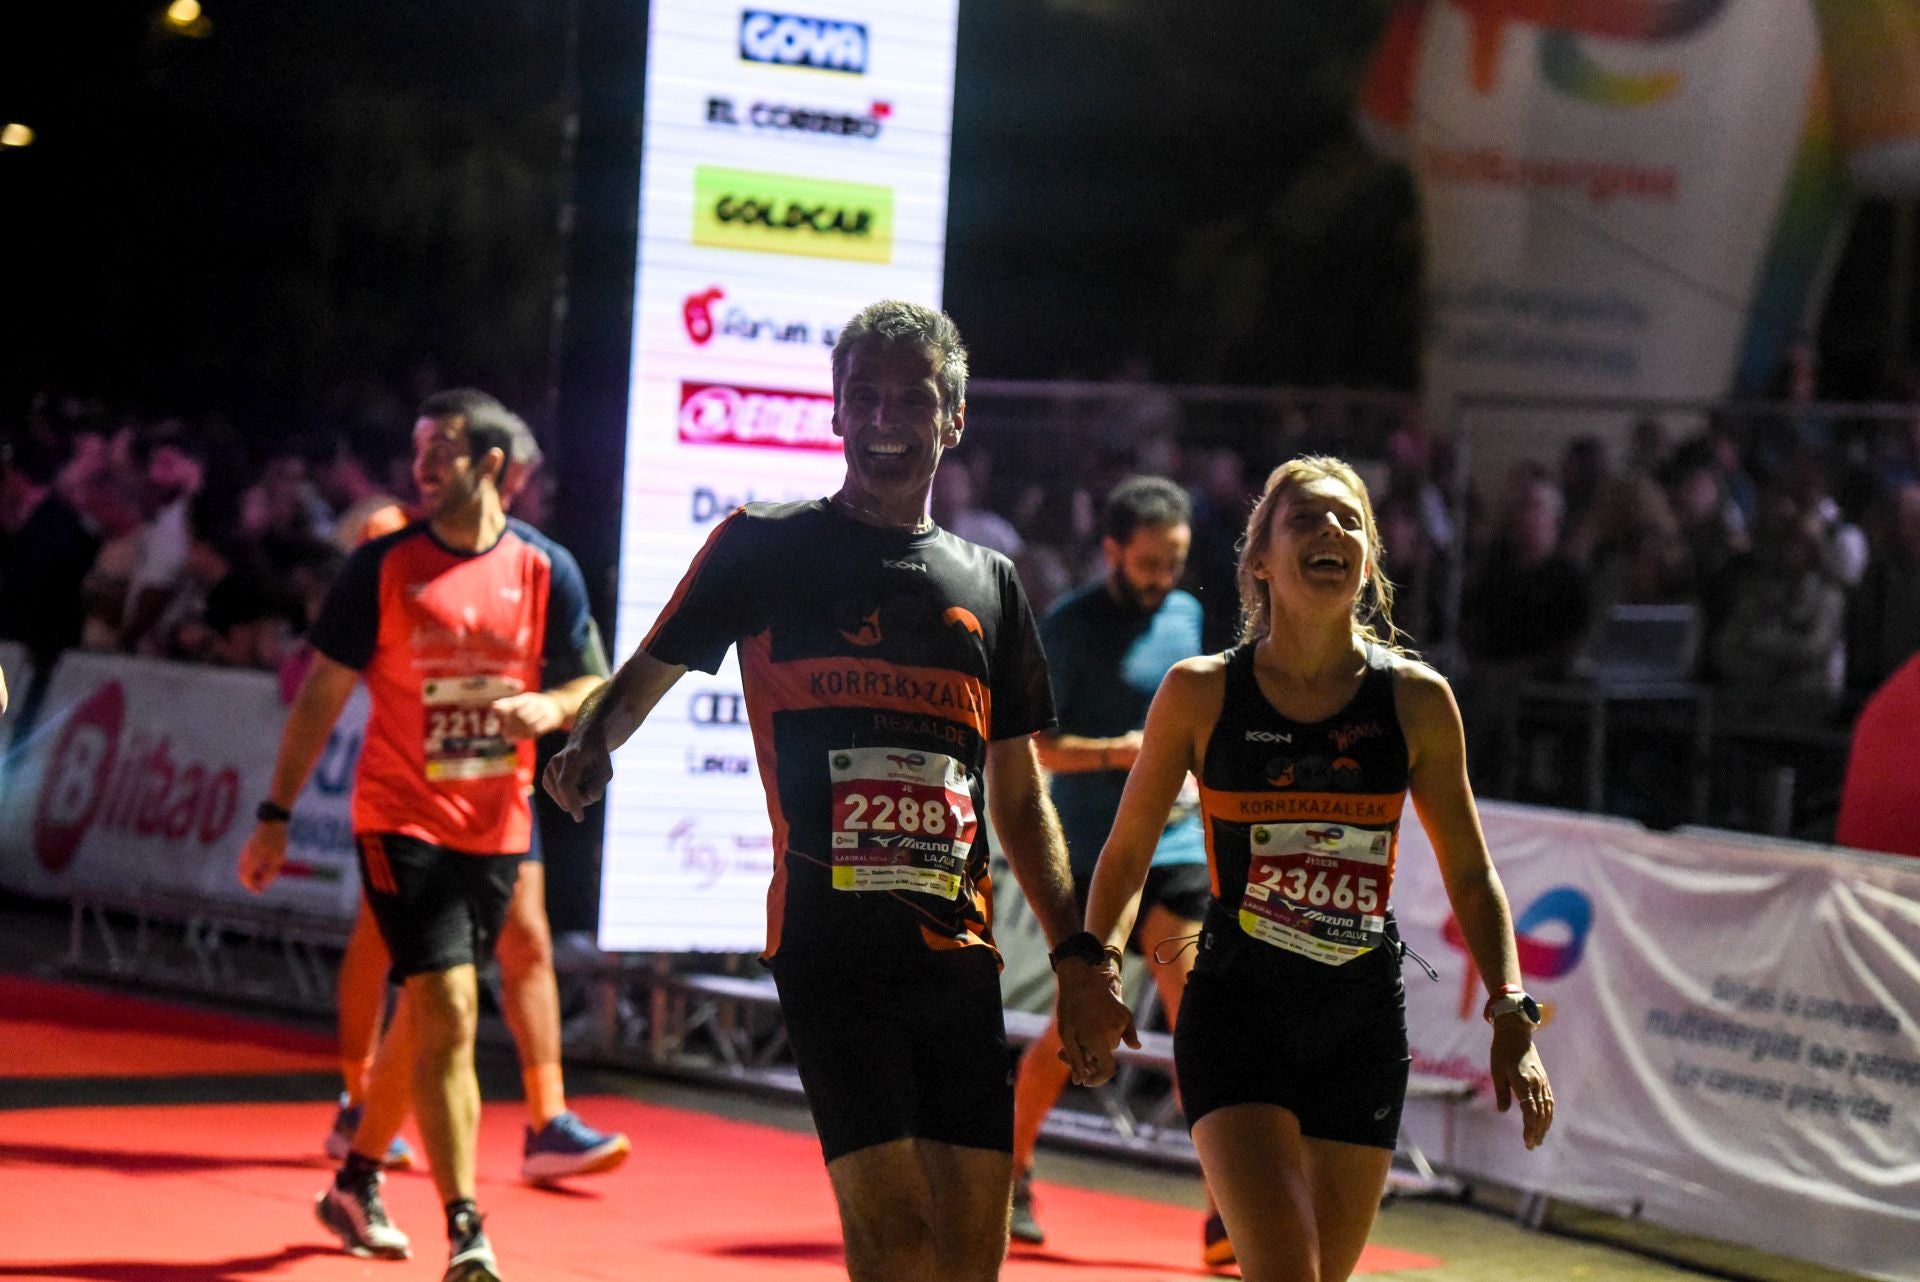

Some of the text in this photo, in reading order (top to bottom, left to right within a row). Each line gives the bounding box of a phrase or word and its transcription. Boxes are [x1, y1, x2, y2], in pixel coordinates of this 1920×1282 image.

[707, 97, 738, 124] EL
[715, 194, 874, 234] GOLDCAR
[1240, 799, 1386, 817] KORRIKAZALEAK
[1258, 864, 1379, 913] 23665
[1326, 927, 1340, 937] LA
